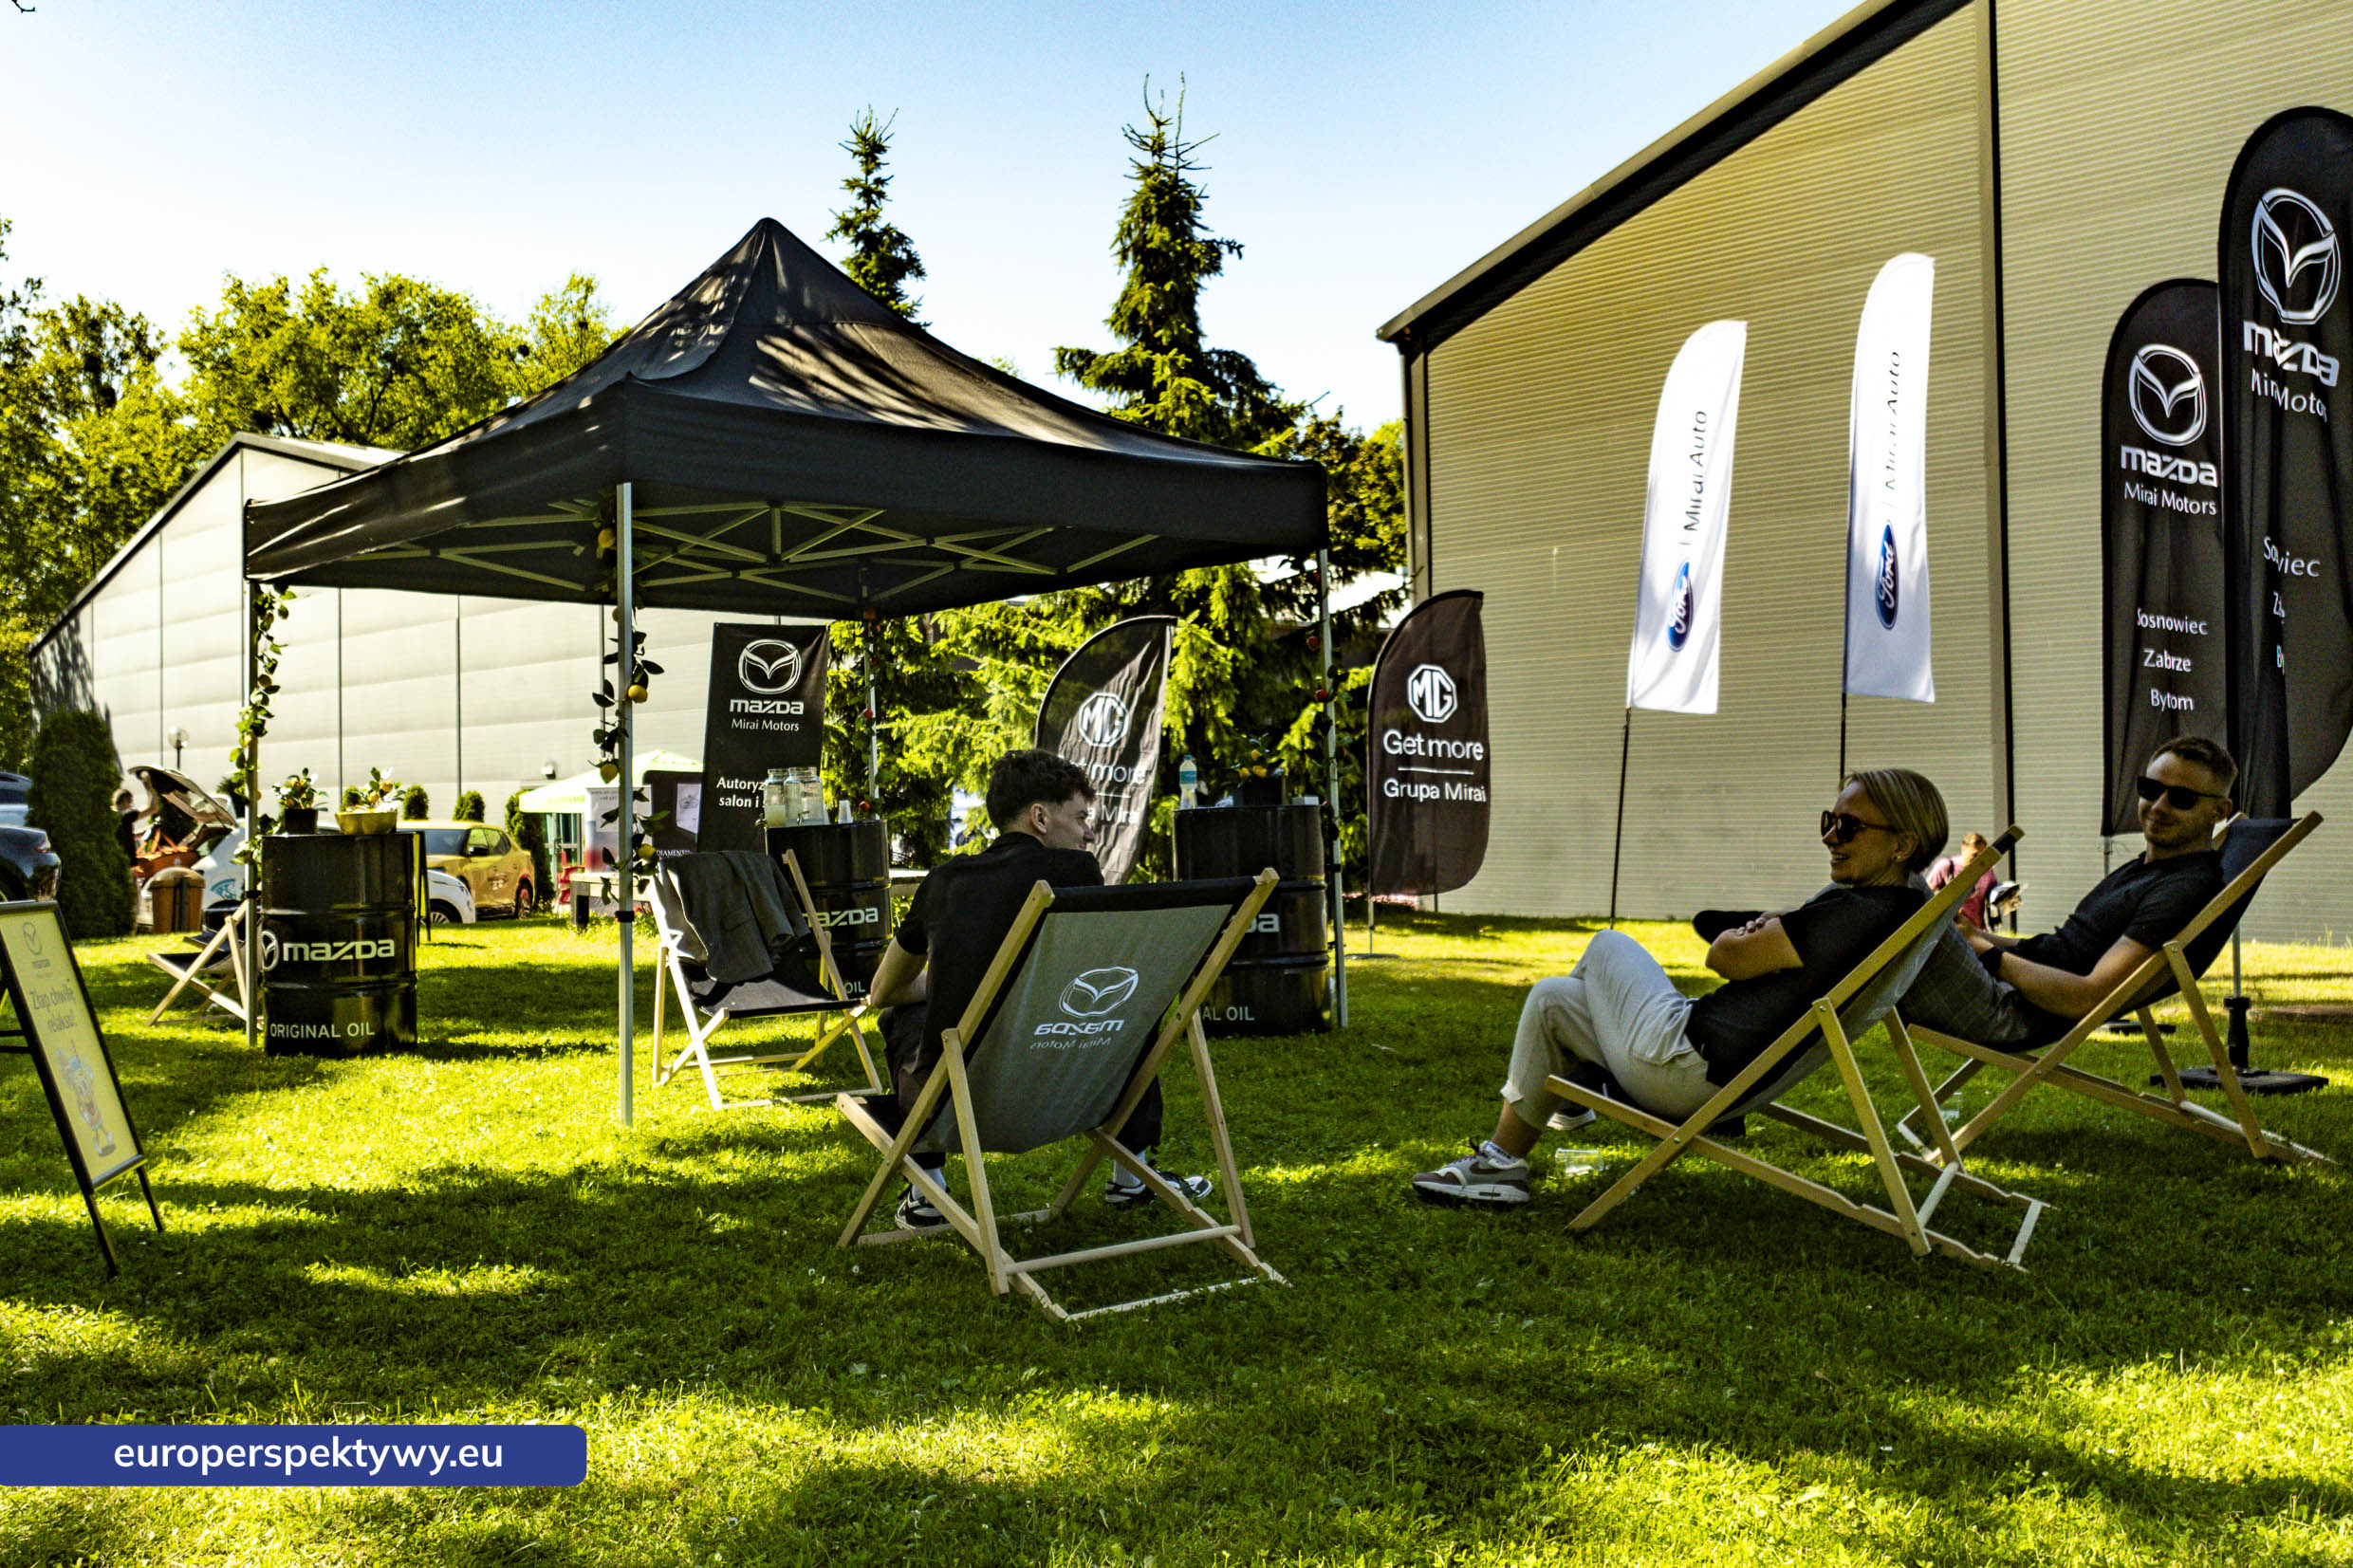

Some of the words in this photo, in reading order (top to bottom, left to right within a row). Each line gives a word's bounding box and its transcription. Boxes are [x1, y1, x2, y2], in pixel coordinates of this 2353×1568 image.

[1689, 410, 1708, 468] Auto
[2123, 481, 2158, 507] Mirai
[2160, 489, 2217, 516] Motors
[2136, 607, 2209, 636] Sosnowiec
[2142, 647, 2193, 673] Zabrze
[1410, 667, 1455, 721] MG
[2149, 687, 2195, 712] Bytom
[731, 718, 760, 730] Mirai
[761, 719, 800, 732] Motors
[1382, 729, 1426, 756] Get
[1427, 737, 1485, 761] more
[715, 776, 765, 794] Autoryz
[1091, 763, 1147, 785] more
[718, 793, 752, 808] salon
[1382, 777, 1440, 802] Grupa
[1444, 782, 1487, 803] Mirai
[802, 906, 880, 929] azda
[1225, 1005, 1255, 1022] OIL
[269, 1023, 342, 1039] ORIGINAL
[346, 1021, 376, 1037] OIL
